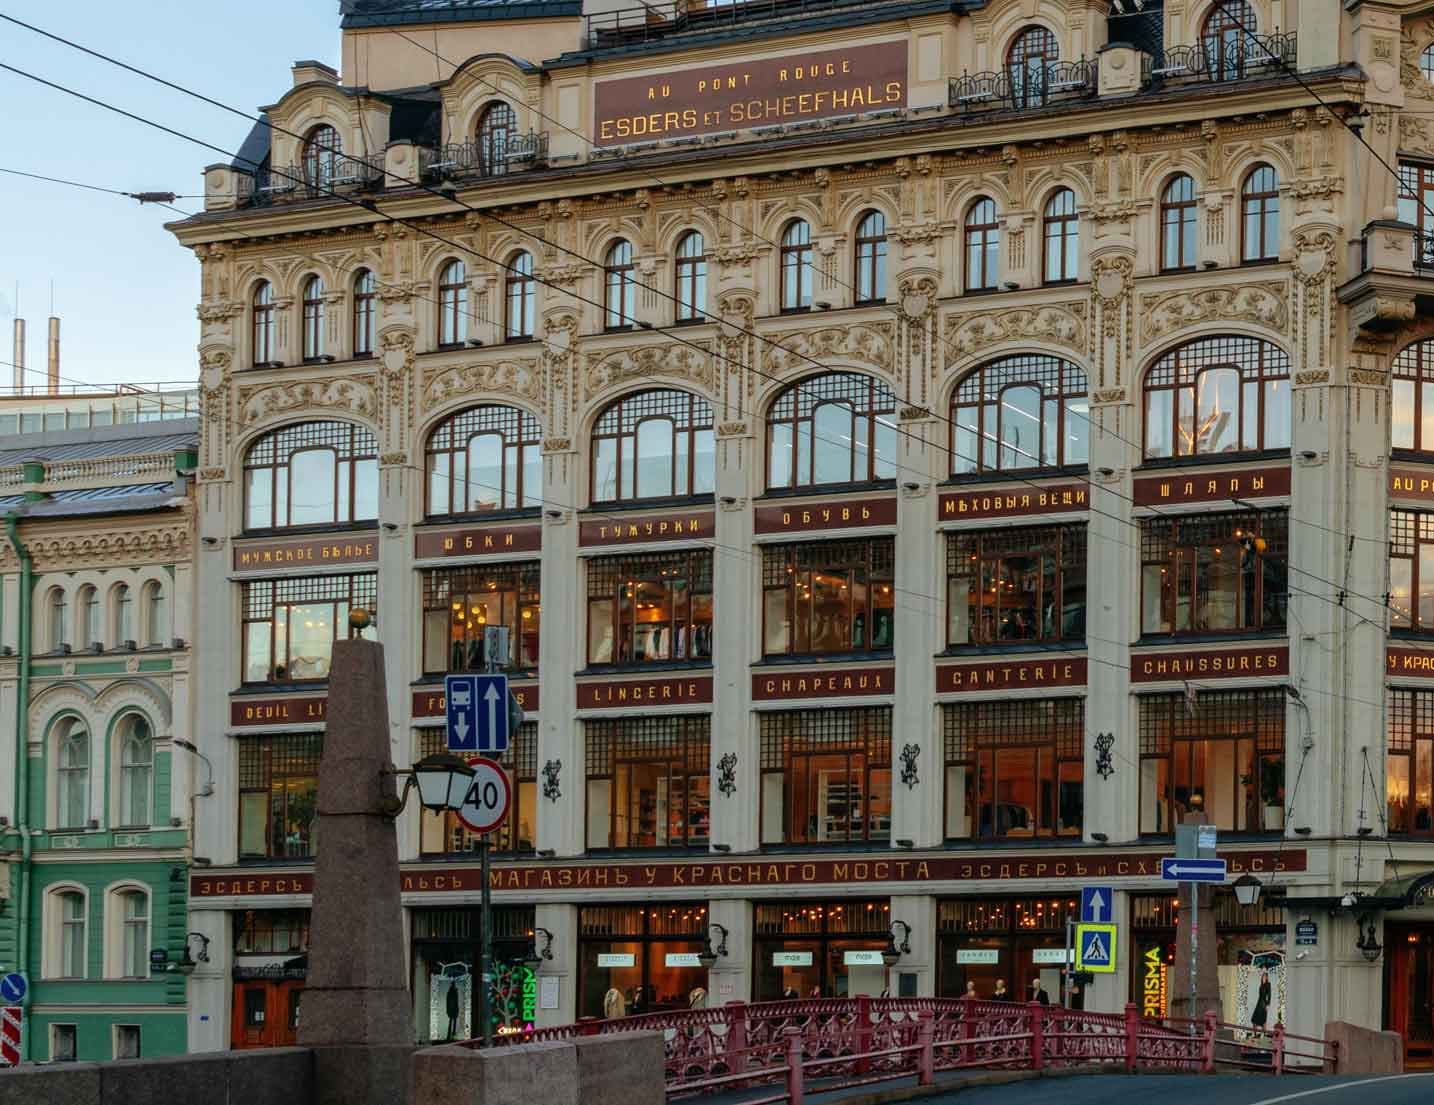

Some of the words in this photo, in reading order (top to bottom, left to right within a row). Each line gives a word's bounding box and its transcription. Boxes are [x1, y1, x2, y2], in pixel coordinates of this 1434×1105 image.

[648, 85, 671, 100] AU
[698, 74, 751, 93] PONT
[779, 60, 851, 81] ROUGE
[600, 109, 698, 140] ESDERS
[703, 111, 721, 127] ET
[729, 81, 902, 123] SCHEEFHALS
[1160, 476, 1265, 497] ШЛЯПЫ
[1393, 477, 1414, 491] AU
[1039, 490, 1086, 507] ВЕЩИ
[783, 507, 870, 526] ОБУВЬ
[599, 519, 700, 539] ТУЖУРКИ
[443, 533, 514, 551] ЮБКИ
[241, 547, 313, 566] МУЖСКОЕ
[1144, 654, 1279, 674] CHAUSSURES
[1388, 654, 1398, 669] У
[766, 675, 882, 693] CHAPEAUX
[952, 664, 1073, 685] GANTERIE
[594, 683, 698, 701] LINGERIE
[246, 703, 289, 719] DEUIL
[465, 781, 498, 810] 40
[489, 867, 628, 890] МАГАЗИНЪ
[645, 868, 656, 885] У
[672, 863, 817, 884] КРАСНАГО
[833, 860, 930, 882] МОСТА
[1144, 945, 1160, 1017] PRISMA
